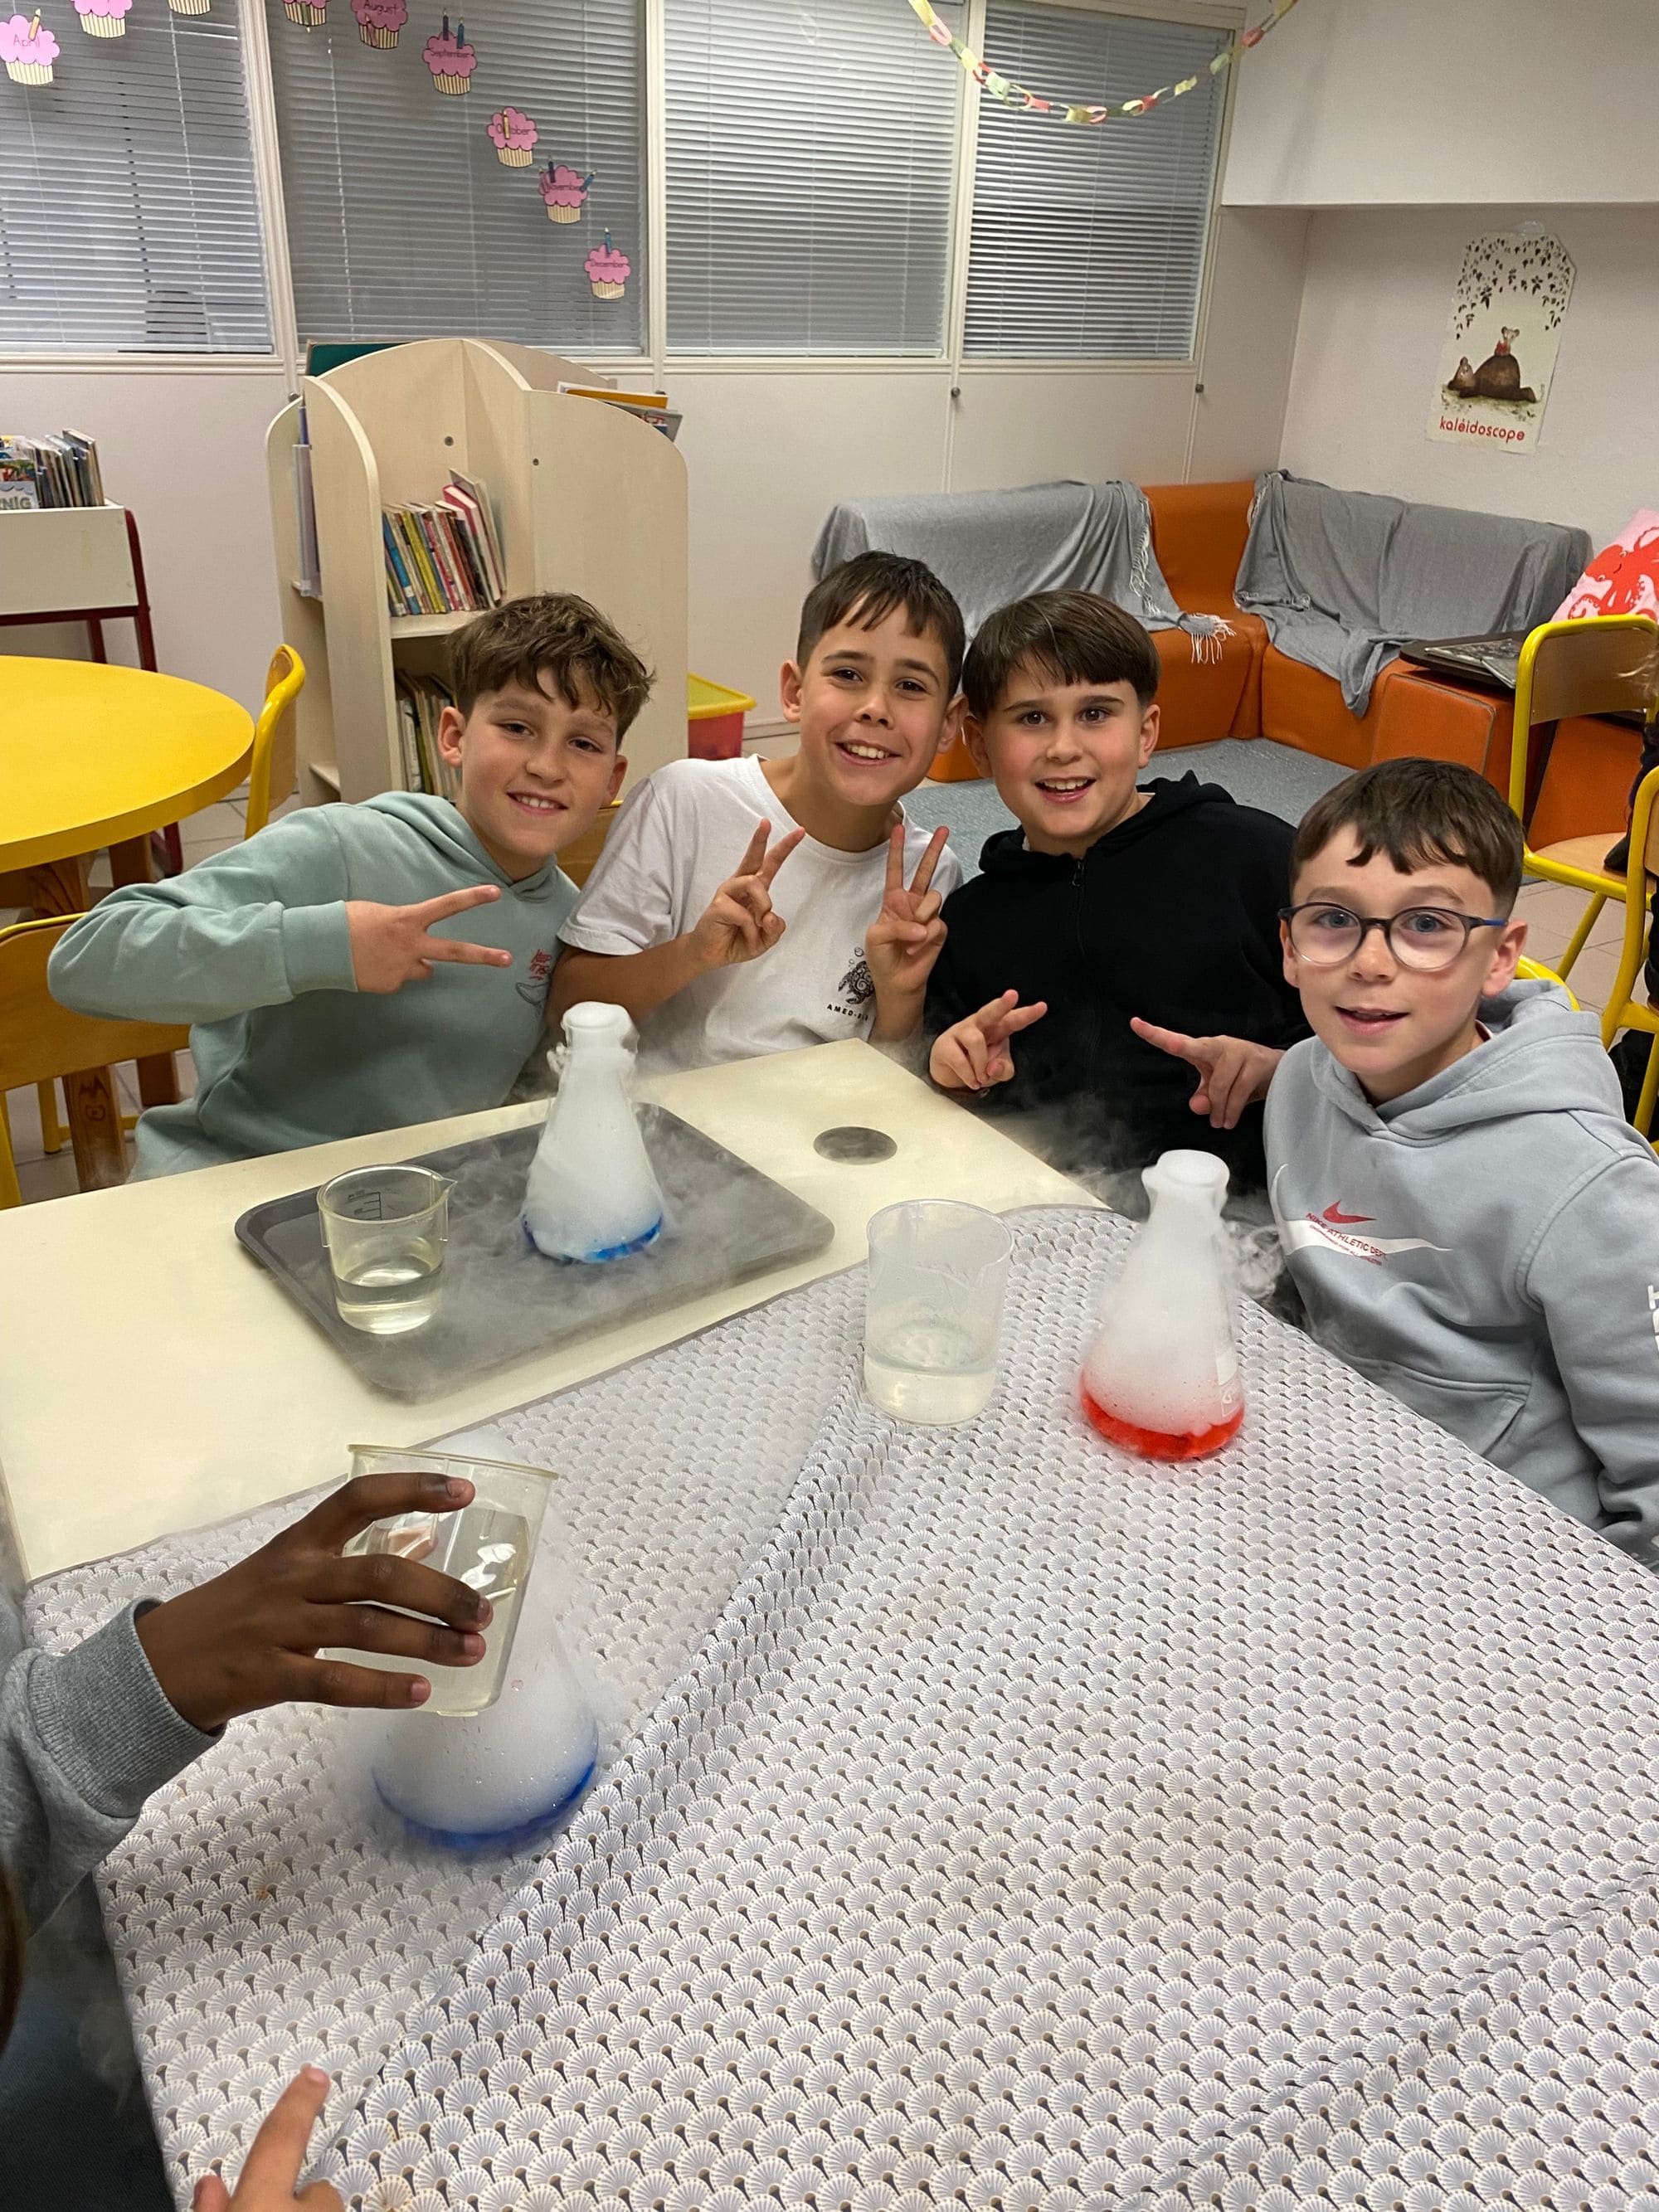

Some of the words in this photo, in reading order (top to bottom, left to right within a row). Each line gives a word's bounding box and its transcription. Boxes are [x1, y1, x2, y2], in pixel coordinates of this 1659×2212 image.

[364, 2, 398, 15] August
[496, 123, 531, 135] Oober
[1439, 416, 1525, 444] kaléidoscope
[0, 496, 32, 509] NIG
[1327, 1228, 1370, 1252] ATHLETIC
